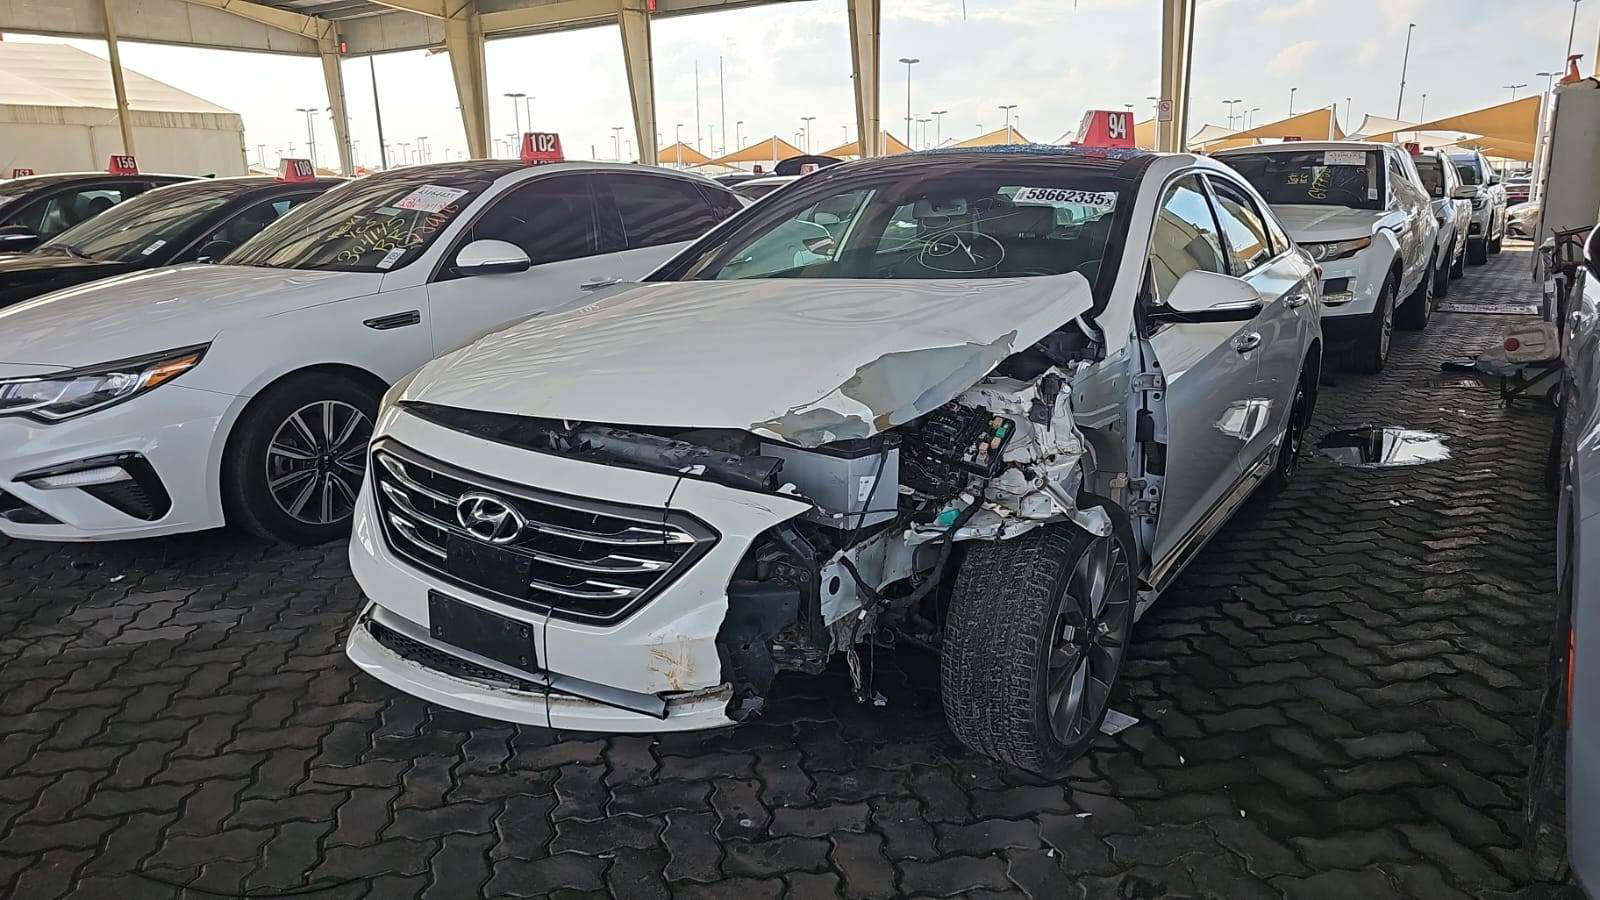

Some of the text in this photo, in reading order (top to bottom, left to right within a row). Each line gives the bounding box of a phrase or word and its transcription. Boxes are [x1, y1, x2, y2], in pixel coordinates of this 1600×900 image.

[1109, 113, 1126, 139] 94
[530, 134, 555, 152] 102
[117, 157, 135, 169] 156
[294, 160, 312, 177] 108
